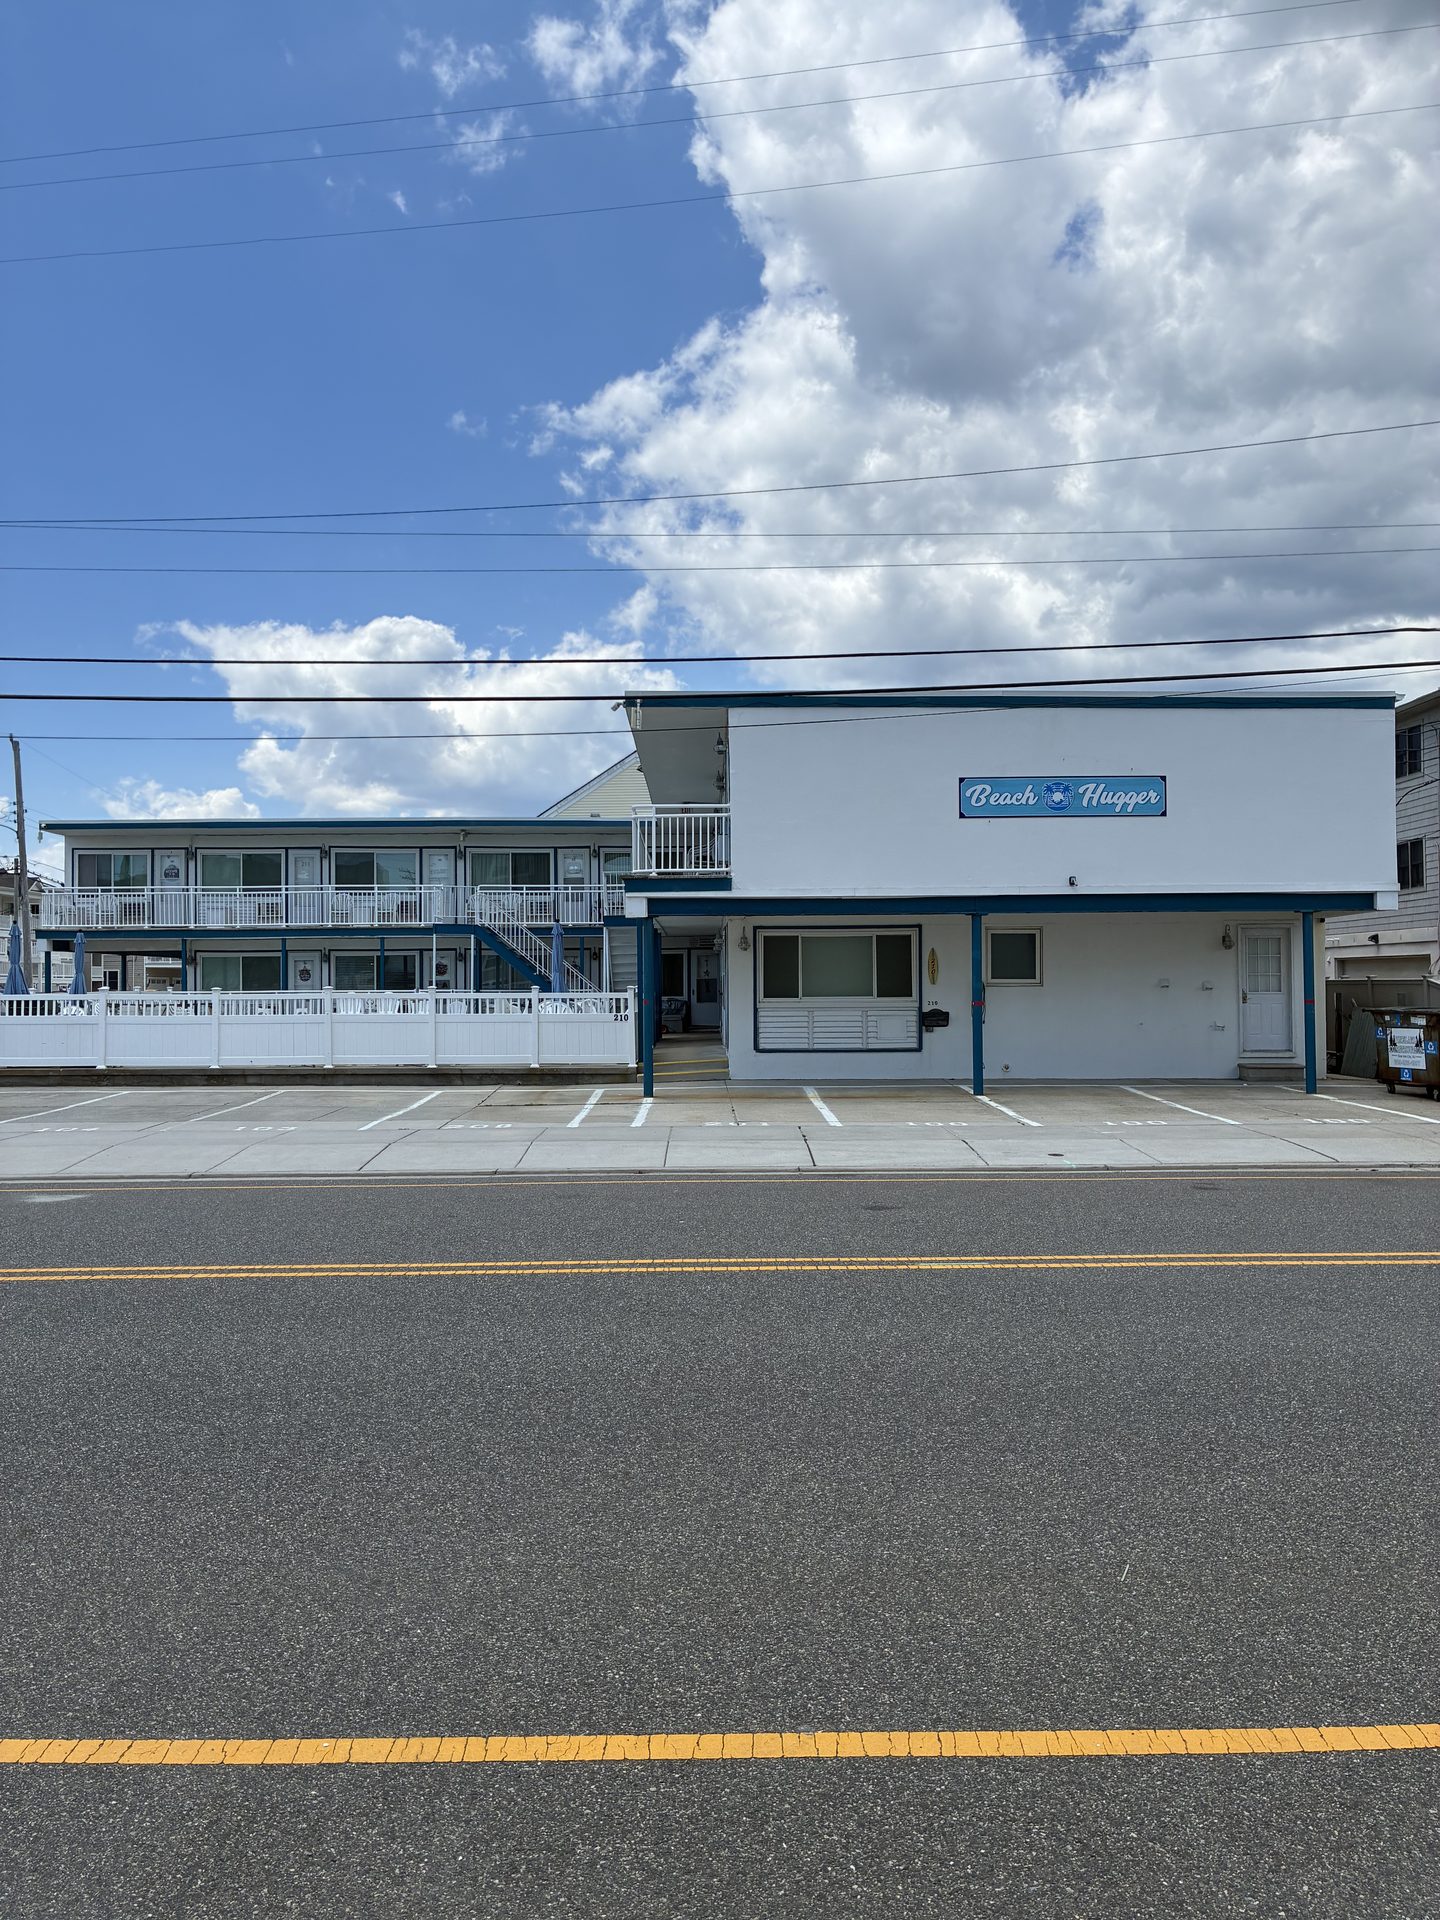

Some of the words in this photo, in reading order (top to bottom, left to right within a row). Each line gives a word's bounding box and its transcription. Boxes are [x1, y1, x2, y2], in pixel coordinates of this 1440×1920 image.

[965, 784, 1038, 807] Beach
[1078, 783, 1160, 813] Hugger
[613, 1013, 629, 1022] 210
